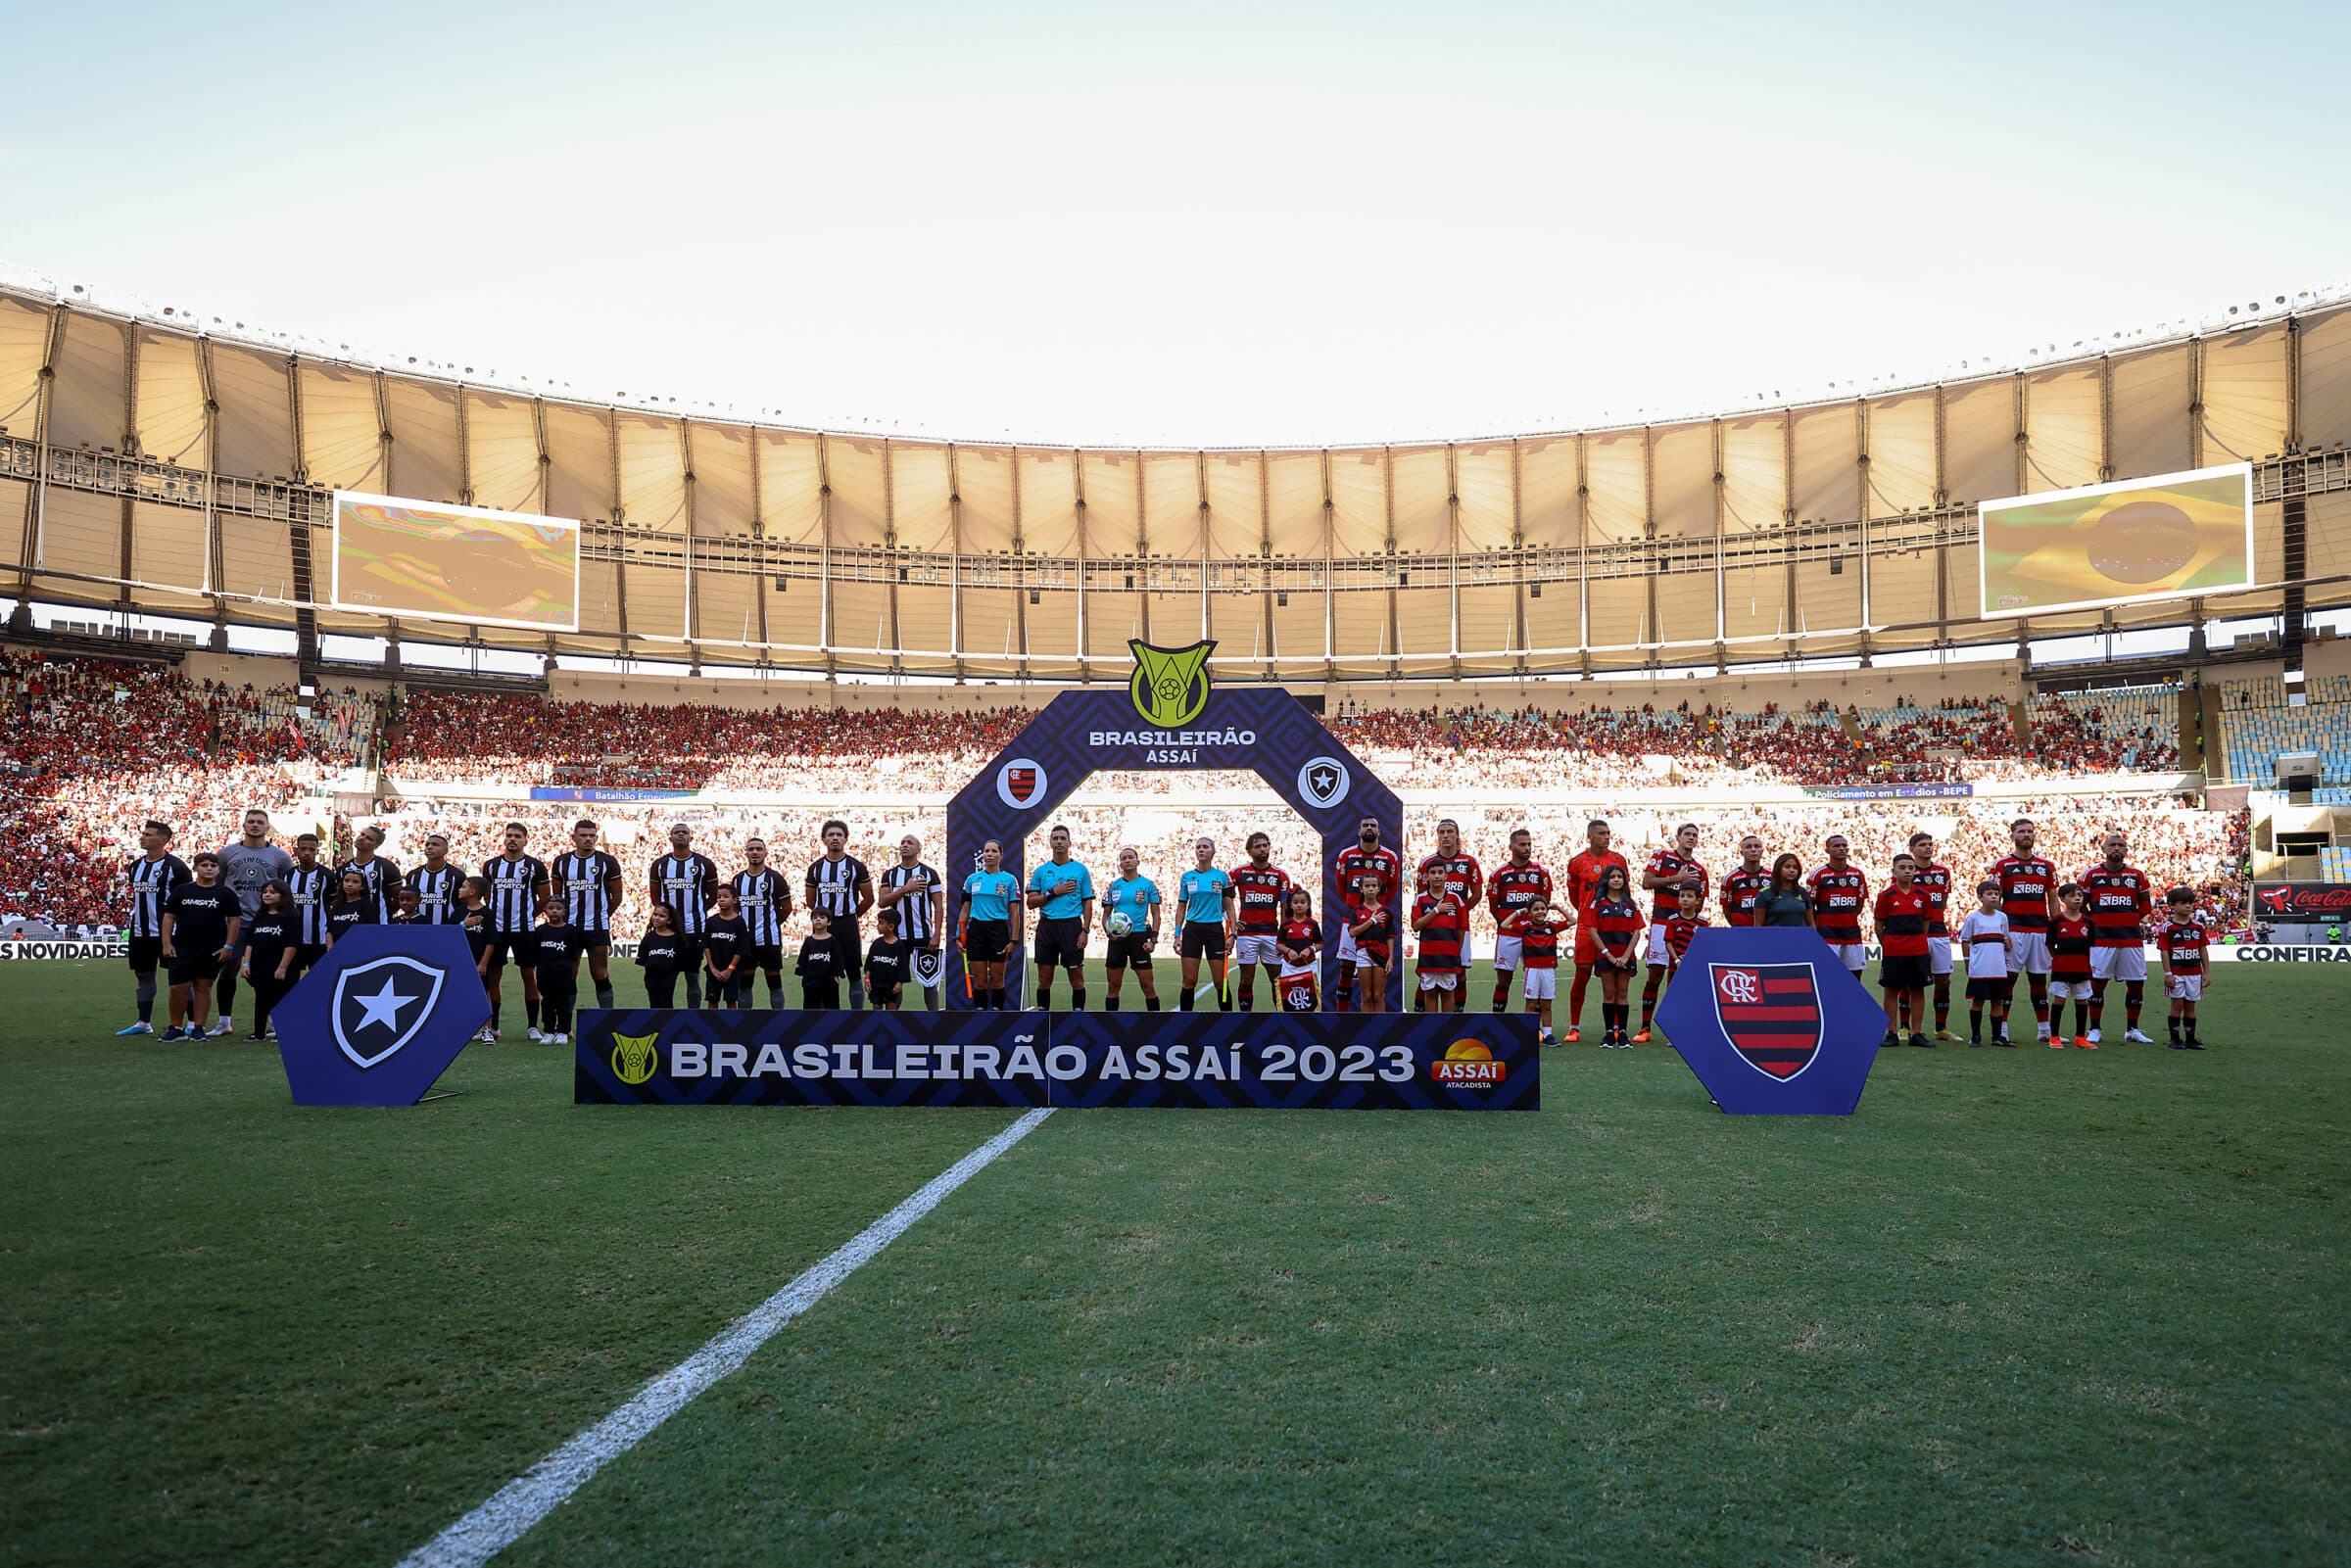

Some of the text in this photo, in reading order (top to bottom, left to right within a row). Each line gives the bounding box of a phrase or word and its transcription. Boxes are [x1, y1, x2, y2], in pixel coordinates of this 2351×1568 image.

[1089, 727, 1256, 746] BRASILEIRÃO
[1146, 749, 1198, 763] ASSAÍ
[595, 791, 636, 800] Batalhão
[1815, 789, 1876, 799] Policiamento
[1896, 788, 1936, 797] Estádios
[1444, 881, 1464, 891] BRB
[2025, 884, 2044, 894] BRB
[1254, 893, 1273, 903] BRB
[1930, 892, 1943, 902] RB
[0, 943, 129, 959] S NOVIDADES
[2236, 947, 2351, 962] CONFIRA
[671, 1034, 1415, 1082] BRASILEIRÃO ASSAÍ 2023
[1439, 1063, 1497, 1079] ASSAÍ
